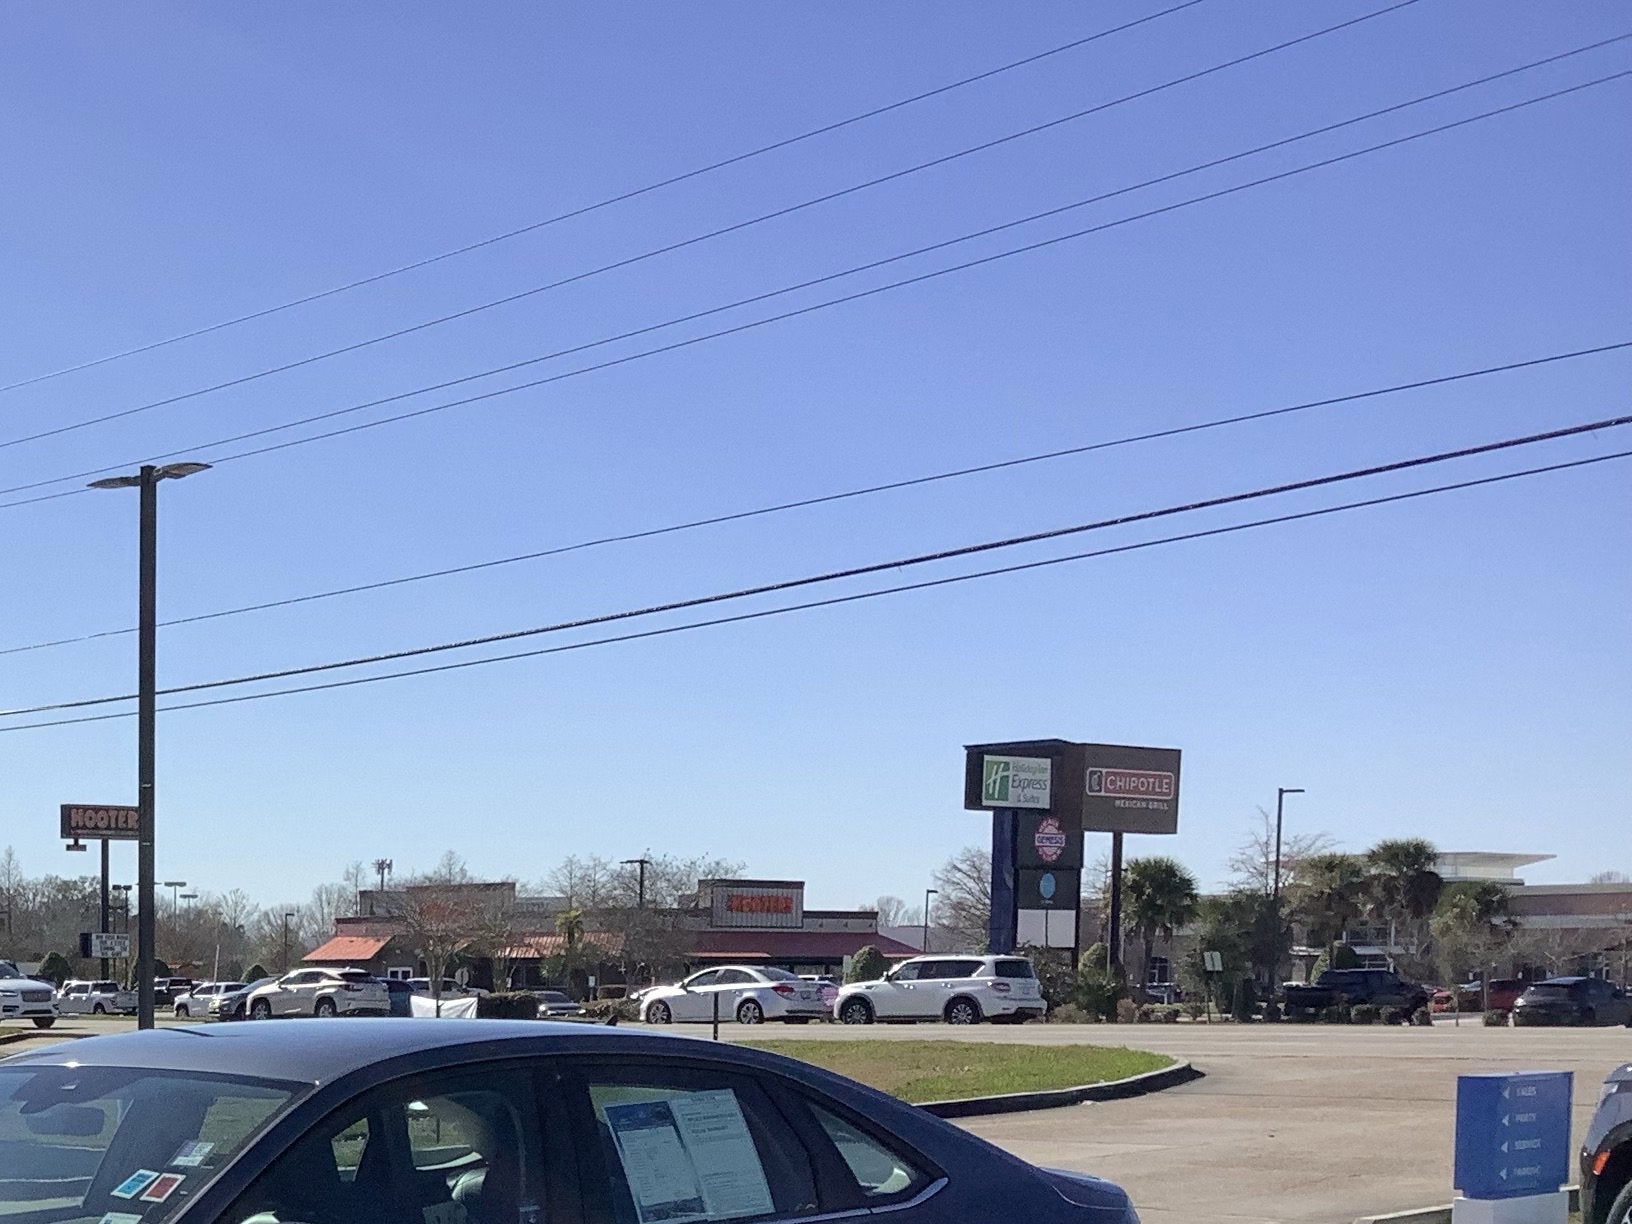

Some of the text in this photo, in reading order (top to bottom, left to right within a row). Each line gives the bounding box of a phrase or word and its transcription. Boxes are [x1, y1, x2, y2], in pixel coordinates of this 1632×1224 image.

[1011, 774, 1047, 793] Express
[1107, 776, 1170, 793] CHIPOTLE
[70, 808, 139, 829] HOOTER
